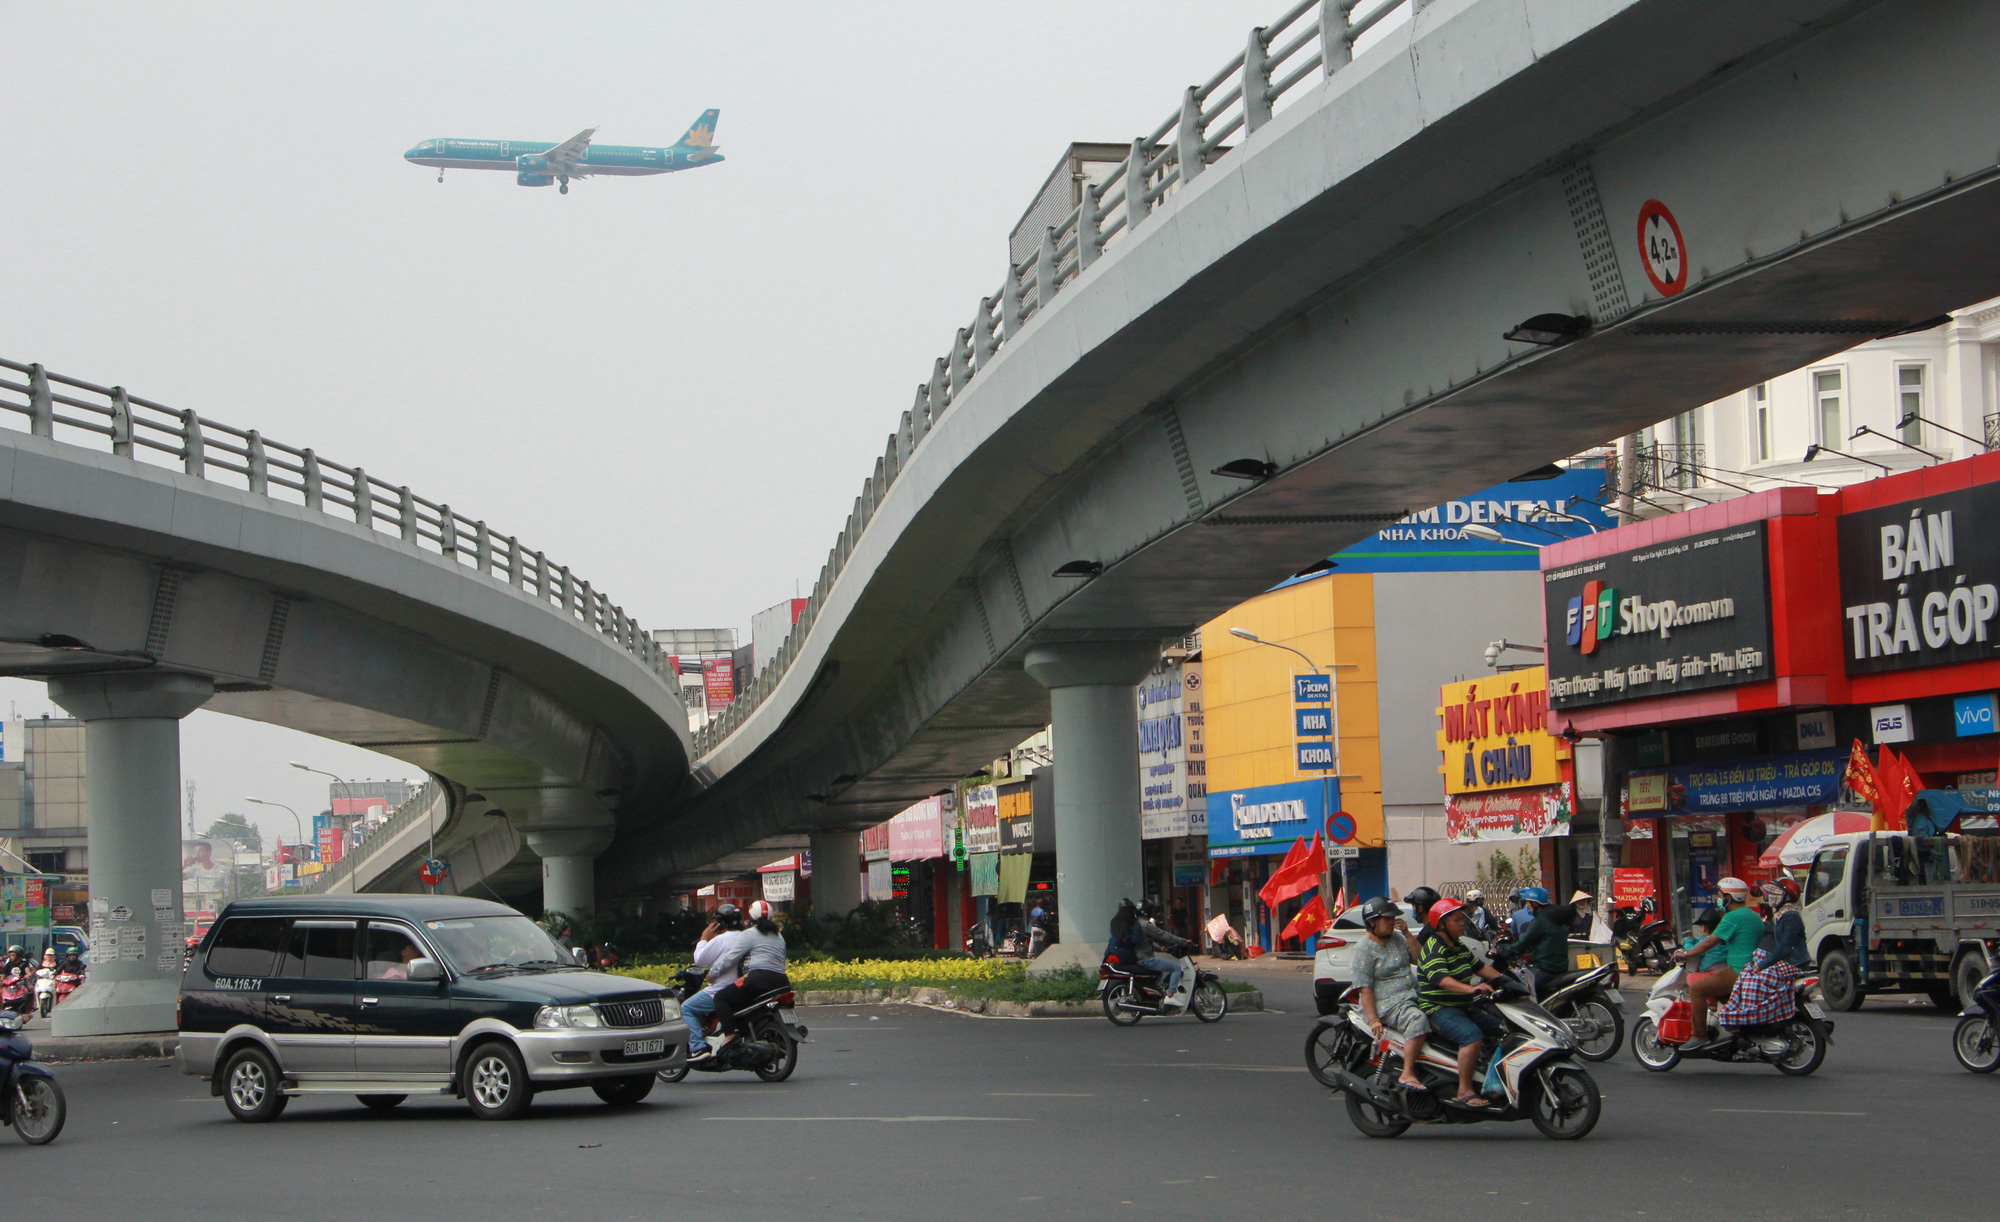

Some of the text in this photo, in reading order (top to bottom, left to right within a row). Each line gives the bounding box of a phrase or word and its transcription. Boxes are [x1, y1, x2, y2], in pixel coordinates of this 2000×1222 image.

[1447, 500, 1573, 523] DENTAL
[1379, 527, 1469, 541] NHA KHOA
[1881, 508, 1954, 580] BÁN
[1566, 601, 1611, 634] FPT
[1846, 574, 1998, 659] TRẢ GÓP
[1573, 672, 1599, 697] thoại
[1604, 667, 1626, 692] Máy
[1628, 664, 1650, 686] tính
[1656, 658, 1679, 684] Máy
[1681, 655, 1704, 678] ảnh
[1711, 651, 1735, 677] Phụ
[1735, 646, 1763, 674] kiện
[1307, 683, 1329, 692] KIM
[1445, 682, 1547, 743] MẮT KÍNH
[1956, 706, 1991, 725] vivo
[1303, 715, 1327, 730] NHA
[1801, 721, 1826, 739] DELL
[1875, 716, 1903, 732] ASUS
[1695, 731, 1757, 748] SAMSUNG Galaxy
[1301, 748, 1332, 763] KHOA
[1463, 736, 1532, 787] Á CHÂU
[1187, 761, 1206, 776] MINH
[1689, 773, 1704, 790] TRỢ
[1705, 769, 1718, 786] GIÁ
[1729, 765, 1745, 784] ĐẾN
[1747, 769, 1754, 782] 10
[1756, 764, 1777, 785] TRIỆU
[1784, 763, 1800, 778] TRẢ
[1801, 758, 1820, 777] GÓP
[1822, 760, 1835, 775] 0%
[1639, 796, 1662, 805] SAMSUNG
[1721, 792, 1728, 804] 88
[1729, 789, 1745, 806] TRIỆU
[1759, 787, 1777, 801] NGÀY
[1783, 786, 1806, 799] MAZDA
[1807, 784, 1821, 797] CX5
[1191, 813, 1205, 824] 04
[321, 845, 332, 853] CA
[322, 855, 332, 864] LI
[1797, 854, 1815, 863] viv
[215, 977, 262, 990] 60A.116.71
